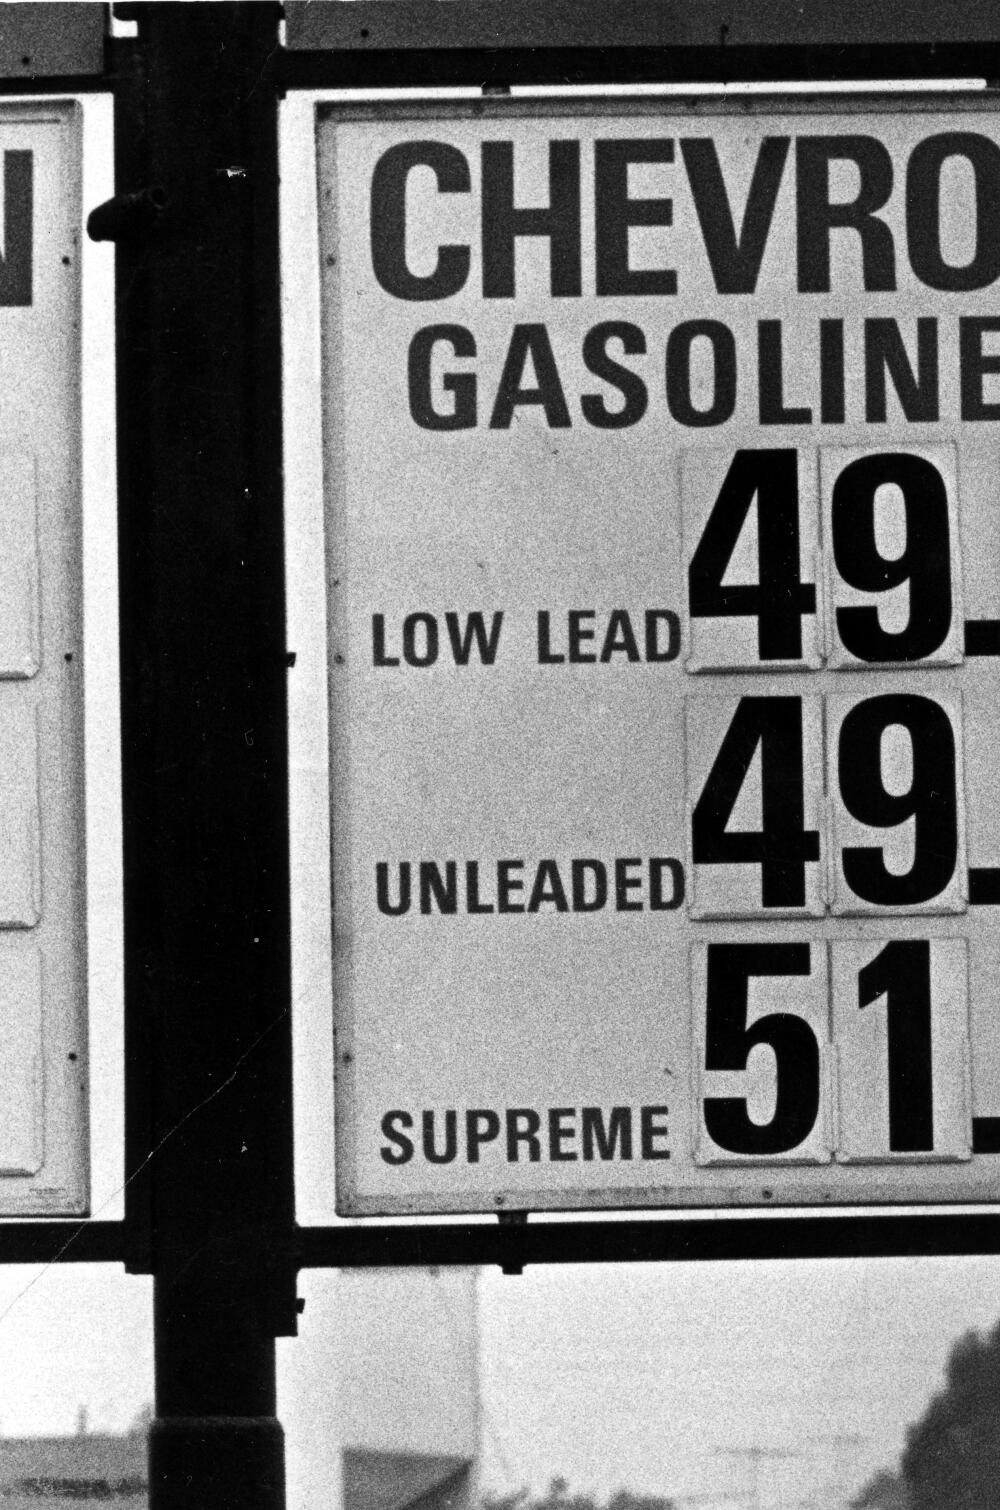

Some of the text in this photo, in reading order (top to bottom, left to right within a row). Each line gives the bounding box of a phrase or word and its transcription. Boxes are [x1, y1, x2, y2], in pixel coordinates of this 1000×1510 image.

[372, 611, 505, 667] LOW
[537, 609, 682, 665] LEAD
[376, 857, 686, 915] UNLEADED
[379, 1105, 670, 1165] SUPREME
